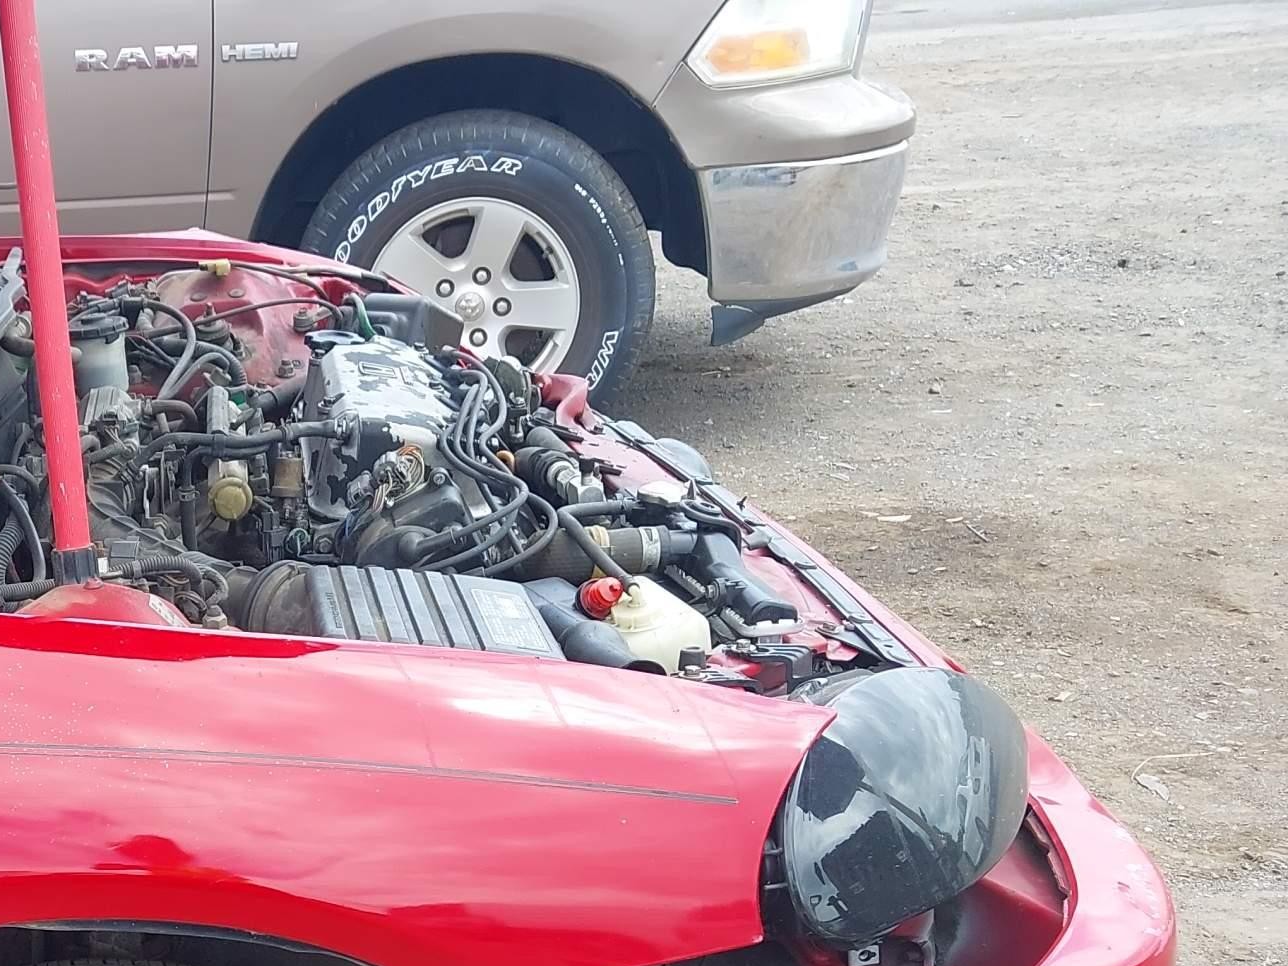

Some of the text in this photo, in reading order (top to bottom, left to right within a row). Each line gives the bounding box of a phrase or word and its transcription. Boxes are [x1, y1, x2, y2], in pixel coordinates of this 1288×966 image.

[74, 44, 199, 72] RAM
[221, 42, 299, 62] HEMI
[335, 155, 523, 265] OODYEAR
